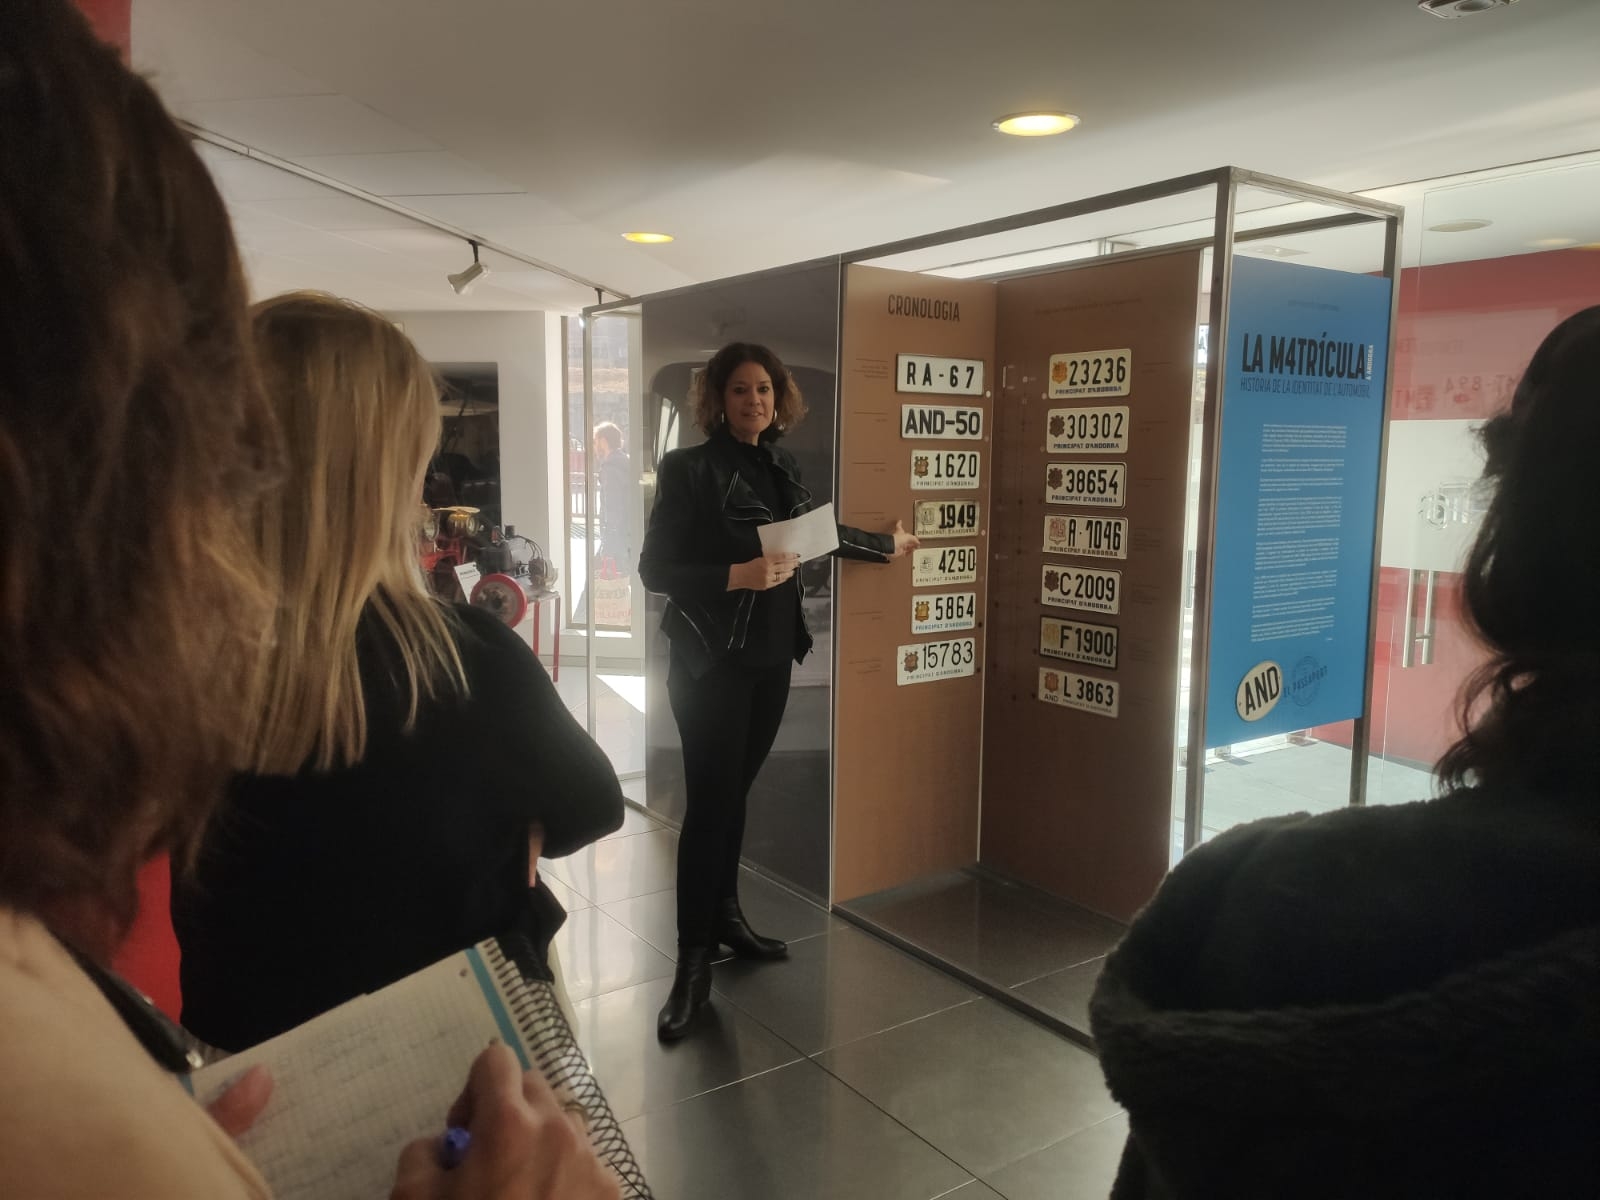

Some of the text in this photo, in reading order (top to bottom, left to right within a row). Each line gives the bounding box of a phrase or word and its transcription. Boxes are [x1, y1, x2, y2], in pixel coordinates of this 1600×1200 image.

[888, 294, 960, 322] CRONOLOGIA
[1242, 333, 1263, 373] LA
[1069, 356, 1127, 386] 23236
[1240, 376, 1271, 393] HISTORIA
[1272, 379, 1281, 393] DE
[1283, 380, 1291, 394] LA
[904, 408, 980, 436] AND-50
[1067, 412, 1123, 439] 30302
[934, 453, 977, 478] 1620
[1066, 469, 1118, 495] 38654
[939, 504, 976, 529] 1949
[938, 548, 975, 573] 4290
[935, 594, 974, 621] 5864
[1048, 596, 1076, 606] PRINCIPAT
[922, 640, 973, 670] 15783
[1044, 692, 1059, 703] AND
[1245, 666, 1280, 716] AND
